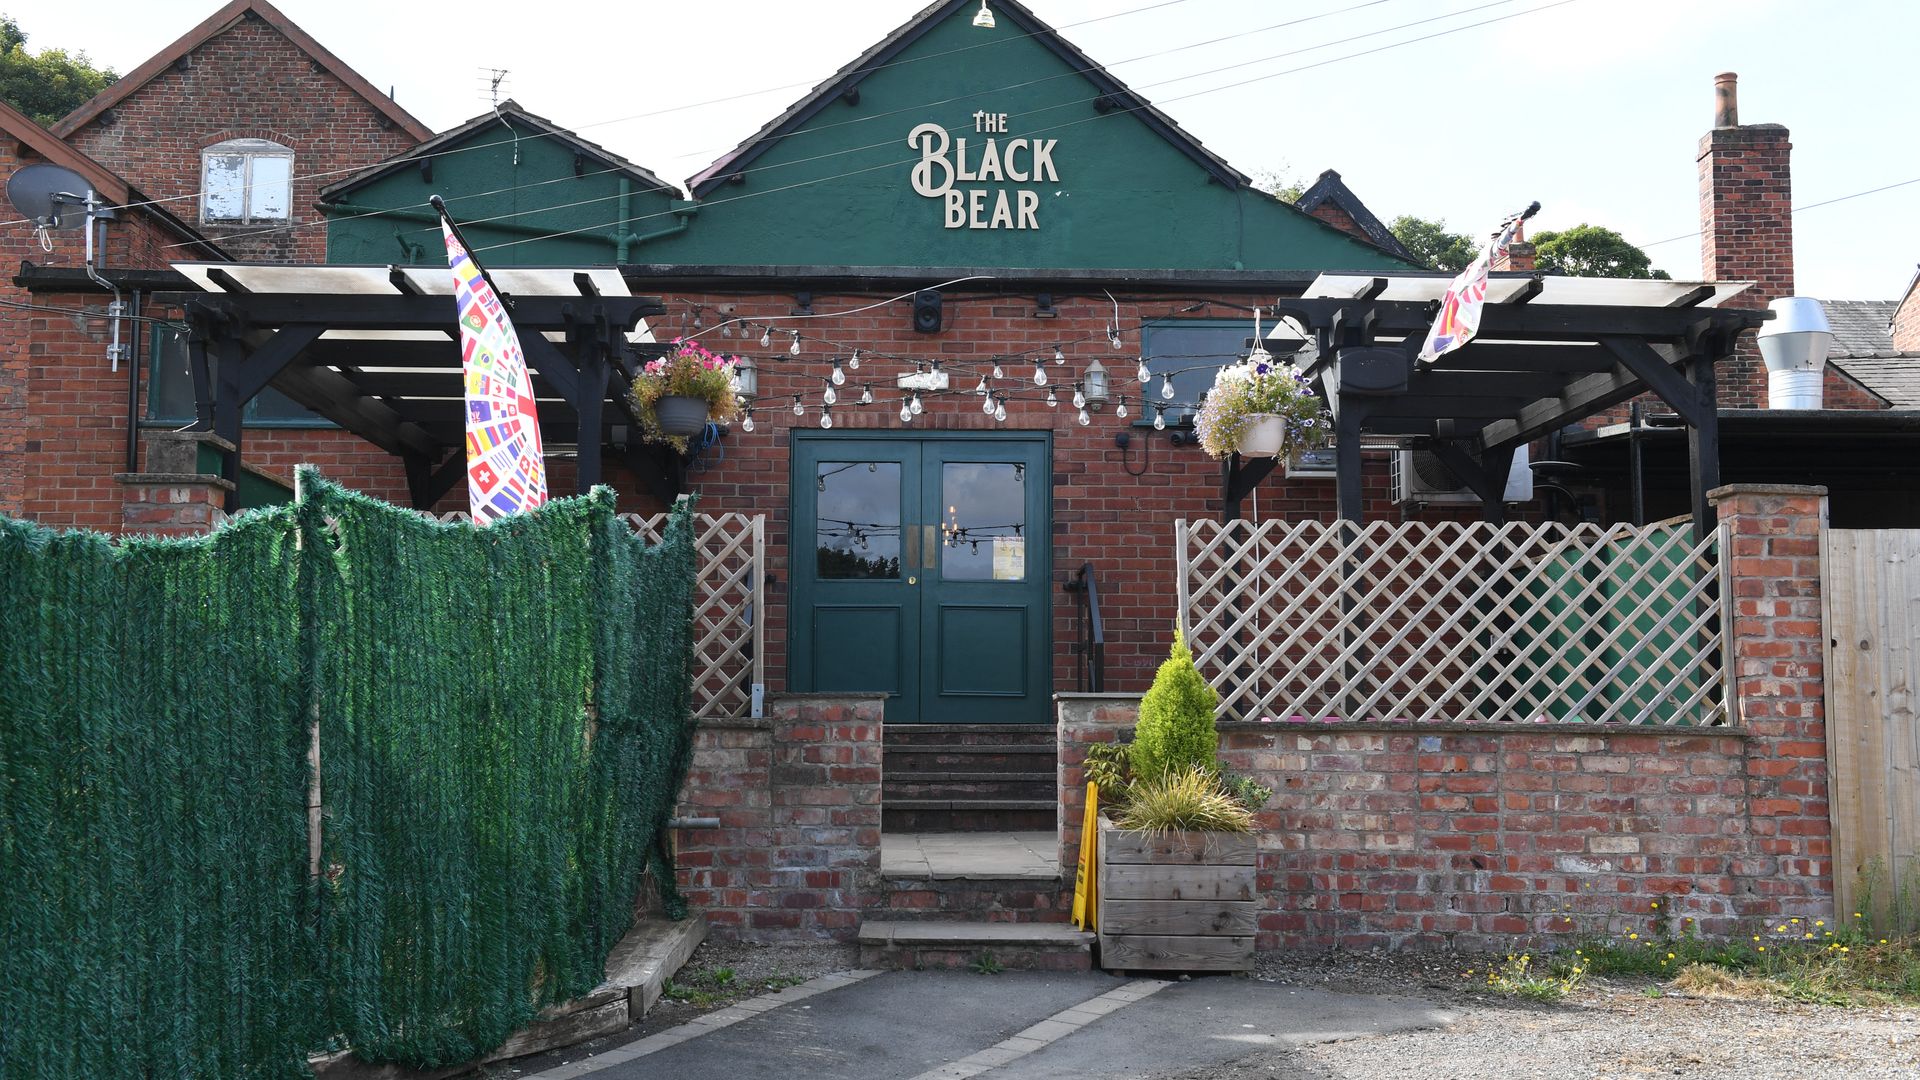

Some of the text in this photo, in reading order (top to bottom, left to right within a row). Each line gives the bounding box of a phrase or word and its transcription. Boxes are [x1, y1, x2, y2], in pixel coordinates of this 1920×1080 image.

[973, 112, 1008, 132] THE
[908, 123, 1059, 197] BLACK
[945, 189, 1039, 229] BEAR
